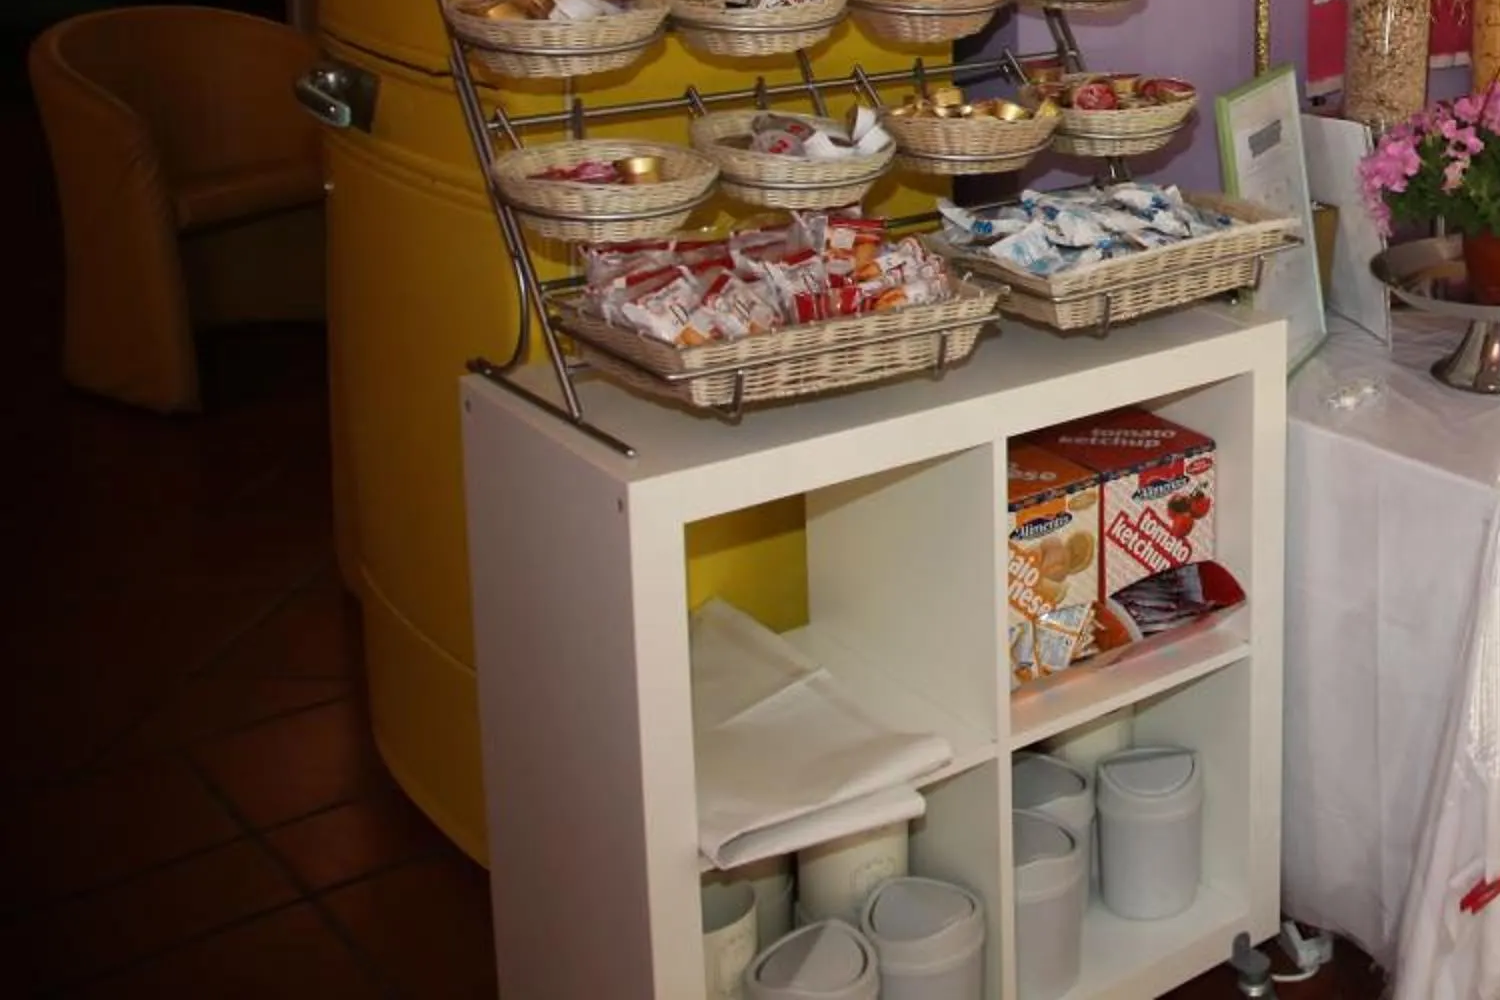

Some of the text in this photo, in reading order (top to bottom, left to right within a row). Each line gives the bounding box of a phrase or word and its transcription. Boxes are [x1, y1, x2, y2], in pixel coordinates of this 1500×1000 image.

[1058, 436, 1161, 449] ketchup
[1091, 428, 1177, 439] tomato
[1110, 515, 1172, 573] ketchup
[1140, 510, 1190, 562] tomato
[1008, 547, 1039, 586] aio
